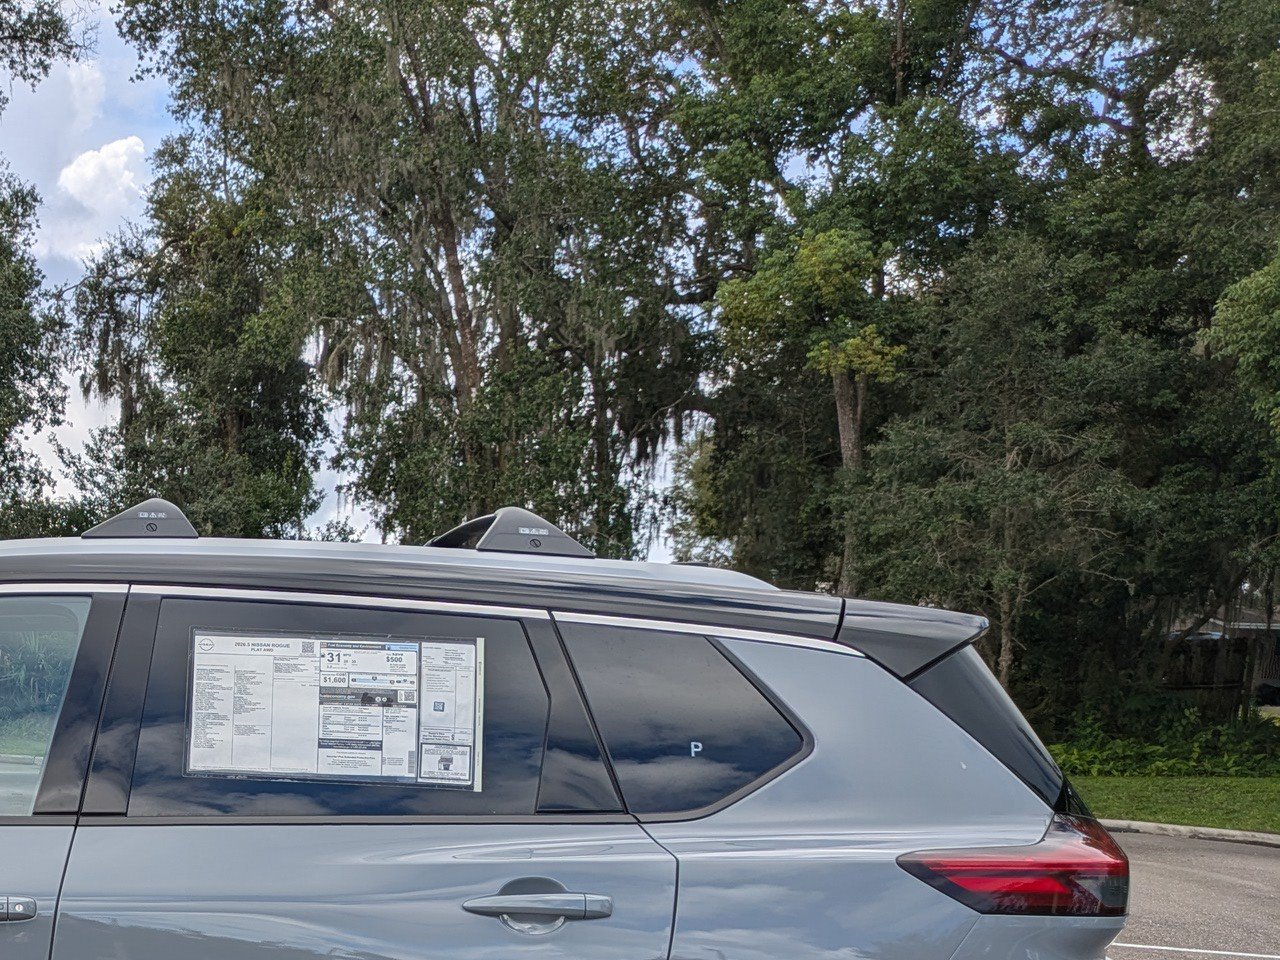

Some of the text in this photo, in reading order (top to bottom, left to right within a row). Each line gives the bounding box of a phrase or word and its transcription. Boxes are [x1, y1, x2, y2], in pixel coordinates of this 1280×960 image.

[327, 652, 341, 663] 31
[323, 676, 347, 684] $1,600
[690, 741, 703, 757] P
